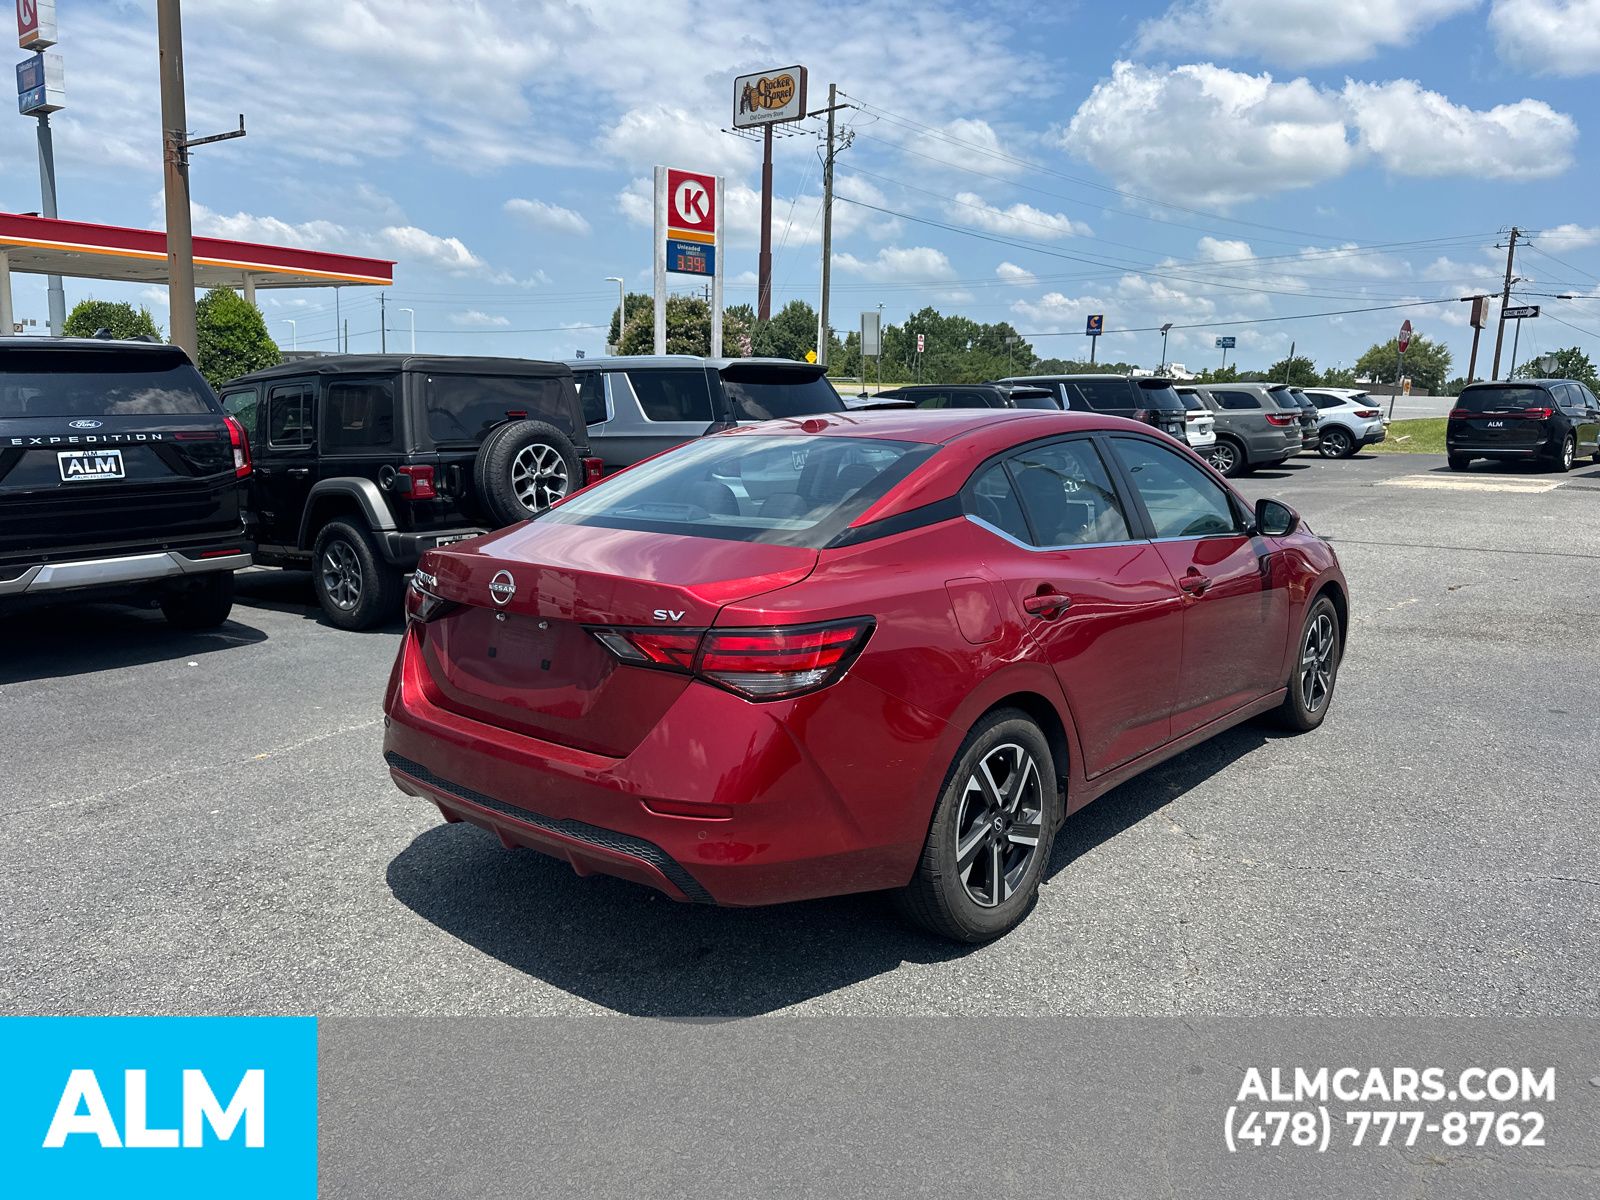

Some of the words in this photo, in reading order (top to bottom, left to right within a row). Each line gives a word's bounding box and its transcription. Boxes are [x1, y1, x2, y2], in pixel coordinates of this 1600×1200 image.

[758, 78, 790, 96] Cracker
[763, 87, 792, 108] Barrel
[684, 188, 706, 221] K
[677, 244, 701, 252] Unleaded
[75, 420, 96, 428] Ford
[10, 434, 163, 445] EXPEDITION
[68, 457, 116, 474] ALM
[653, 609, 686, 621] SV
